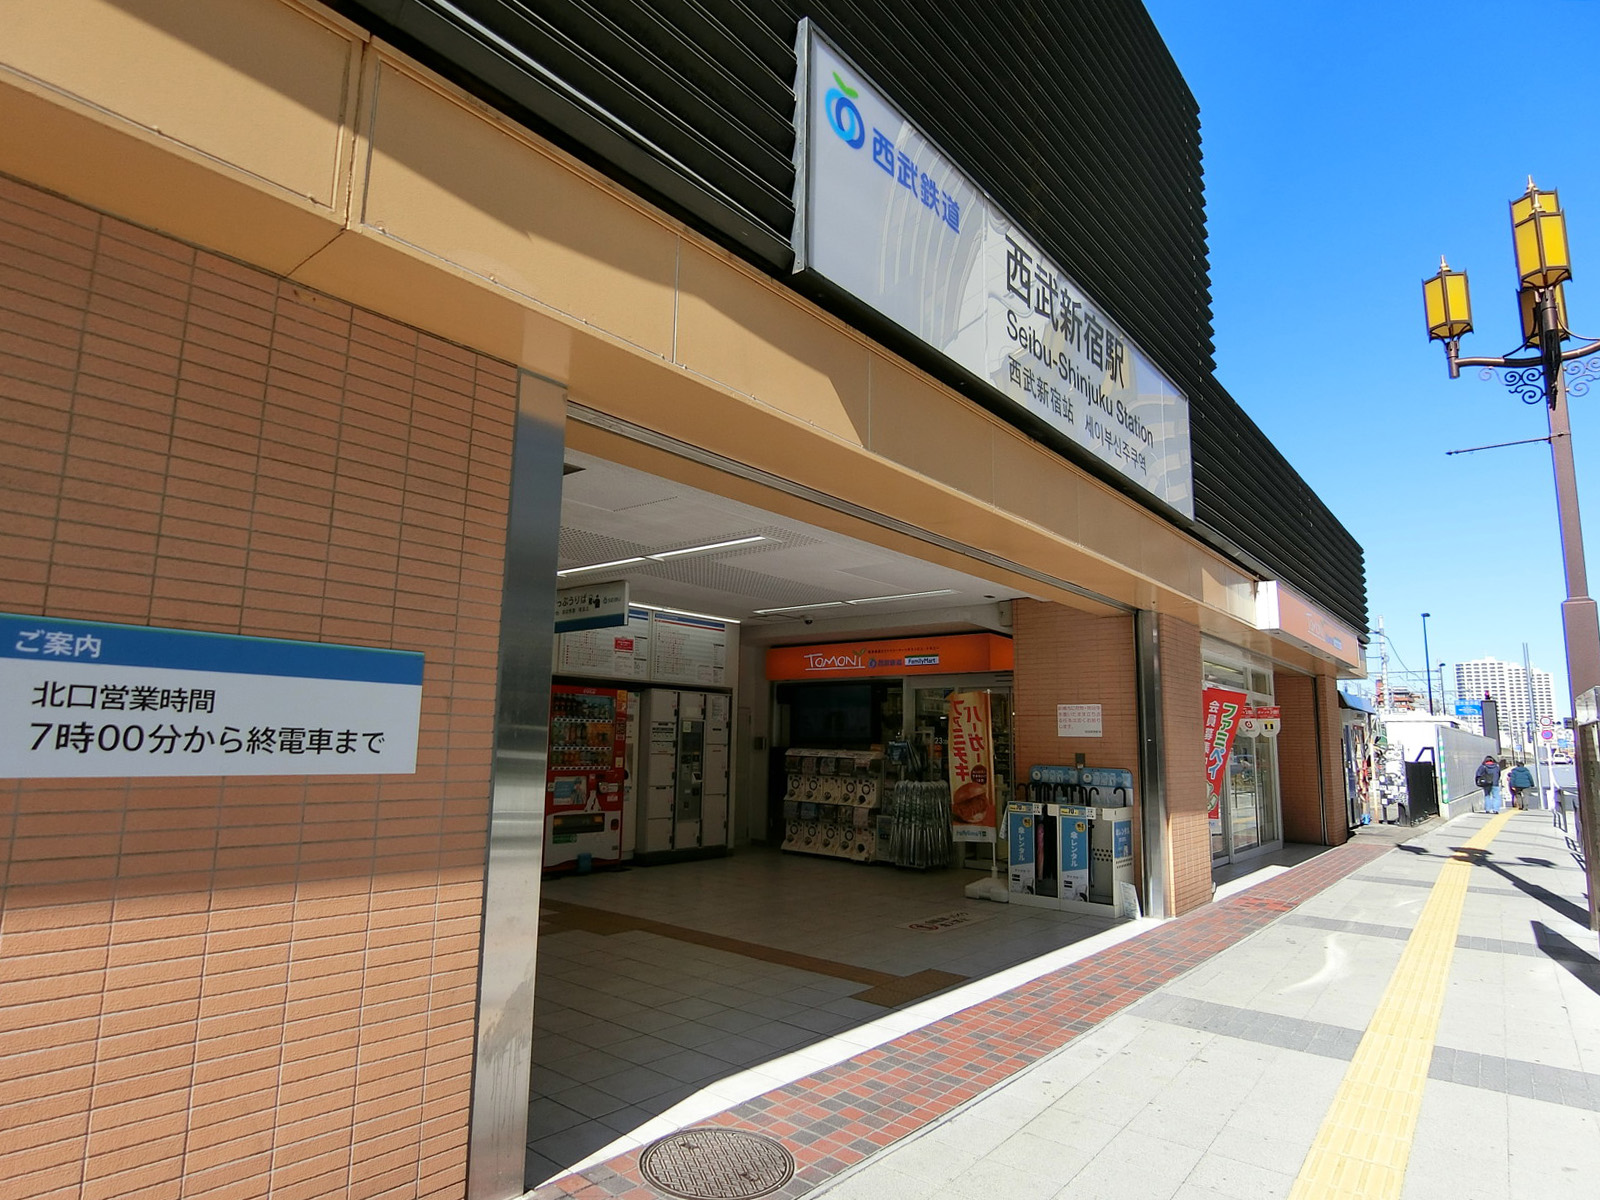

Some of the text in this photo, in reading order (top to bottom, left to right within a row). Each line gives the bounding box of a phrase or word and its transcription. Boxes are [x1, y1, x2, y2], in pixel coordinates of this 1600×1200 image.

[873, 127, 960, 234] 西武鉄道
[1006, 233, 1125, 390] 西武新宿駅
[1006, 310, 1154, 449] Seibu-Shinjuku Station
[1008, 355, 1075, 426] 西武新宿站
[1084, 414, 1148, 476] 세이부신주쿠역
[14, 629, 102, 658] ご案内
[907, 657, 937, 665] FamilyMart
[31, 681, 216, 714] 北口営業時間
[29, 720, 386, 755] 7時00分から終電車まで
[1208, 702, 1238, 780] ファミペイ
